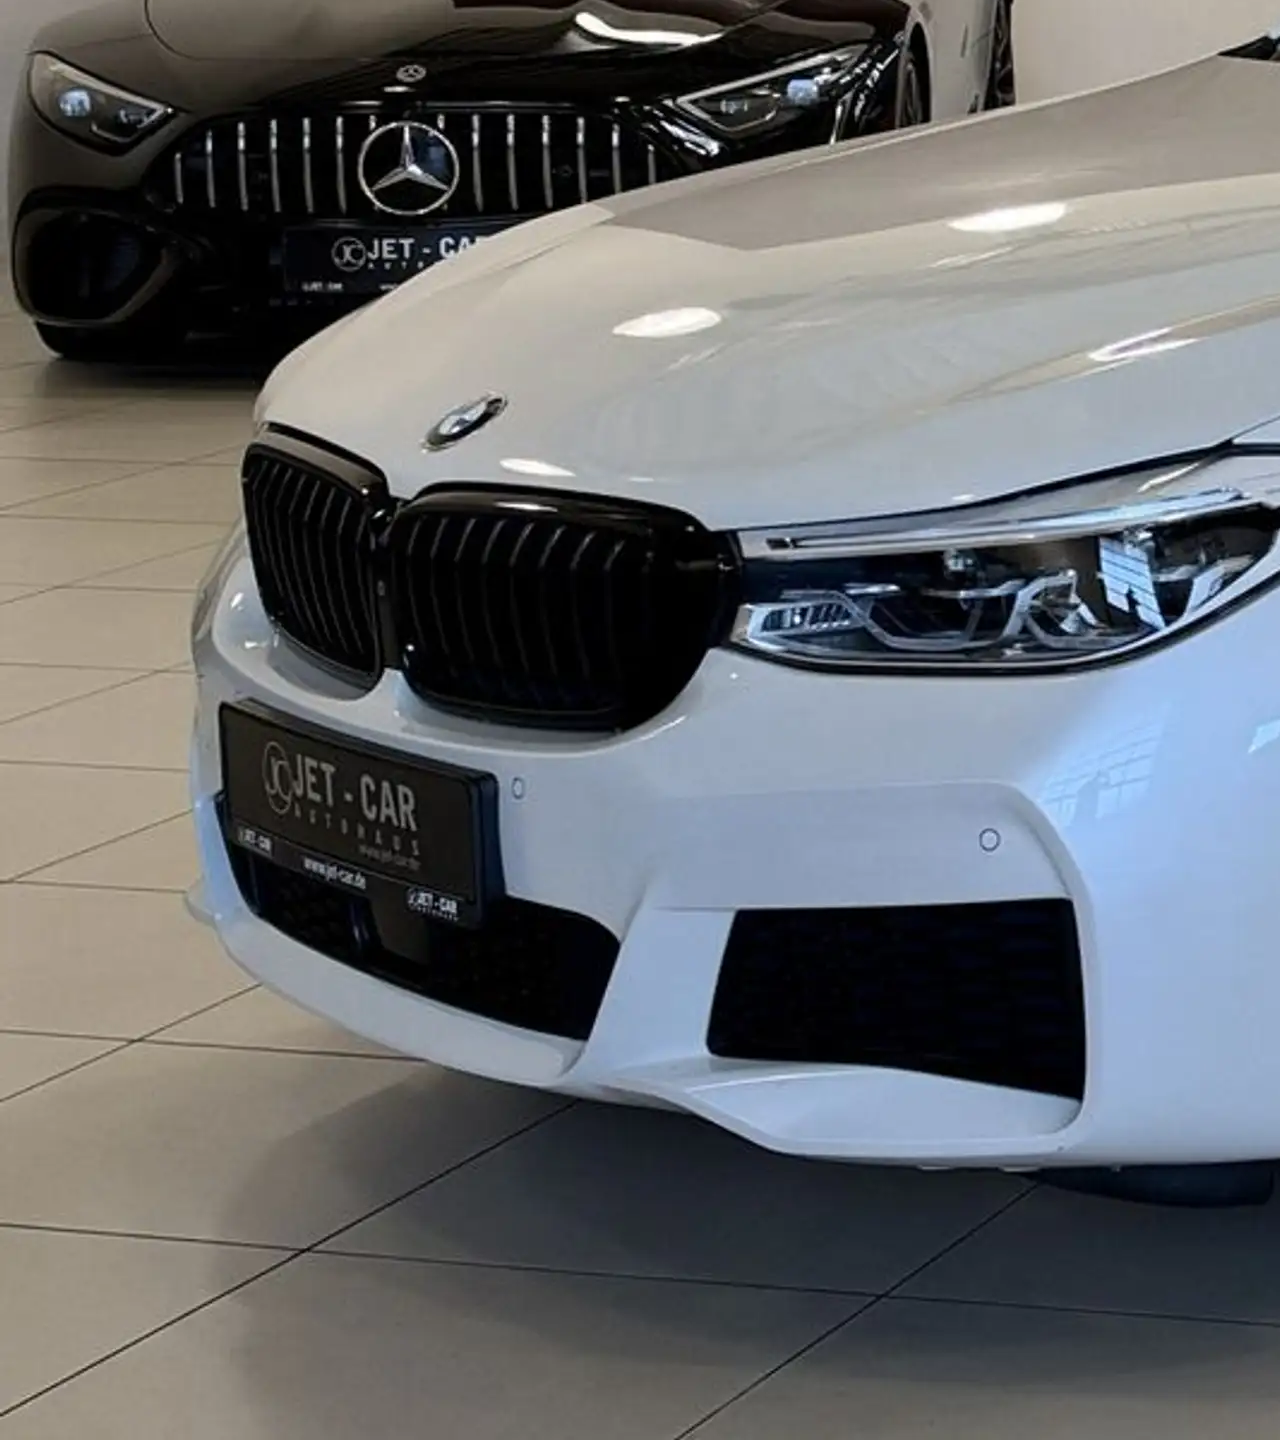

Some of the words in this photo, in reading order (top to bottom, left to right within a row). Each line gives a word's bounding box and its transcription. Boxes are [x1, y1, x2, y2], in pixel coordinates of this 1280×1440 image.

[367, 237, 416, 260] JET
[439, 236, 481, 259] CA
[292, 753, 337, 808] JET
[360, 773, 418, 832] CAR
